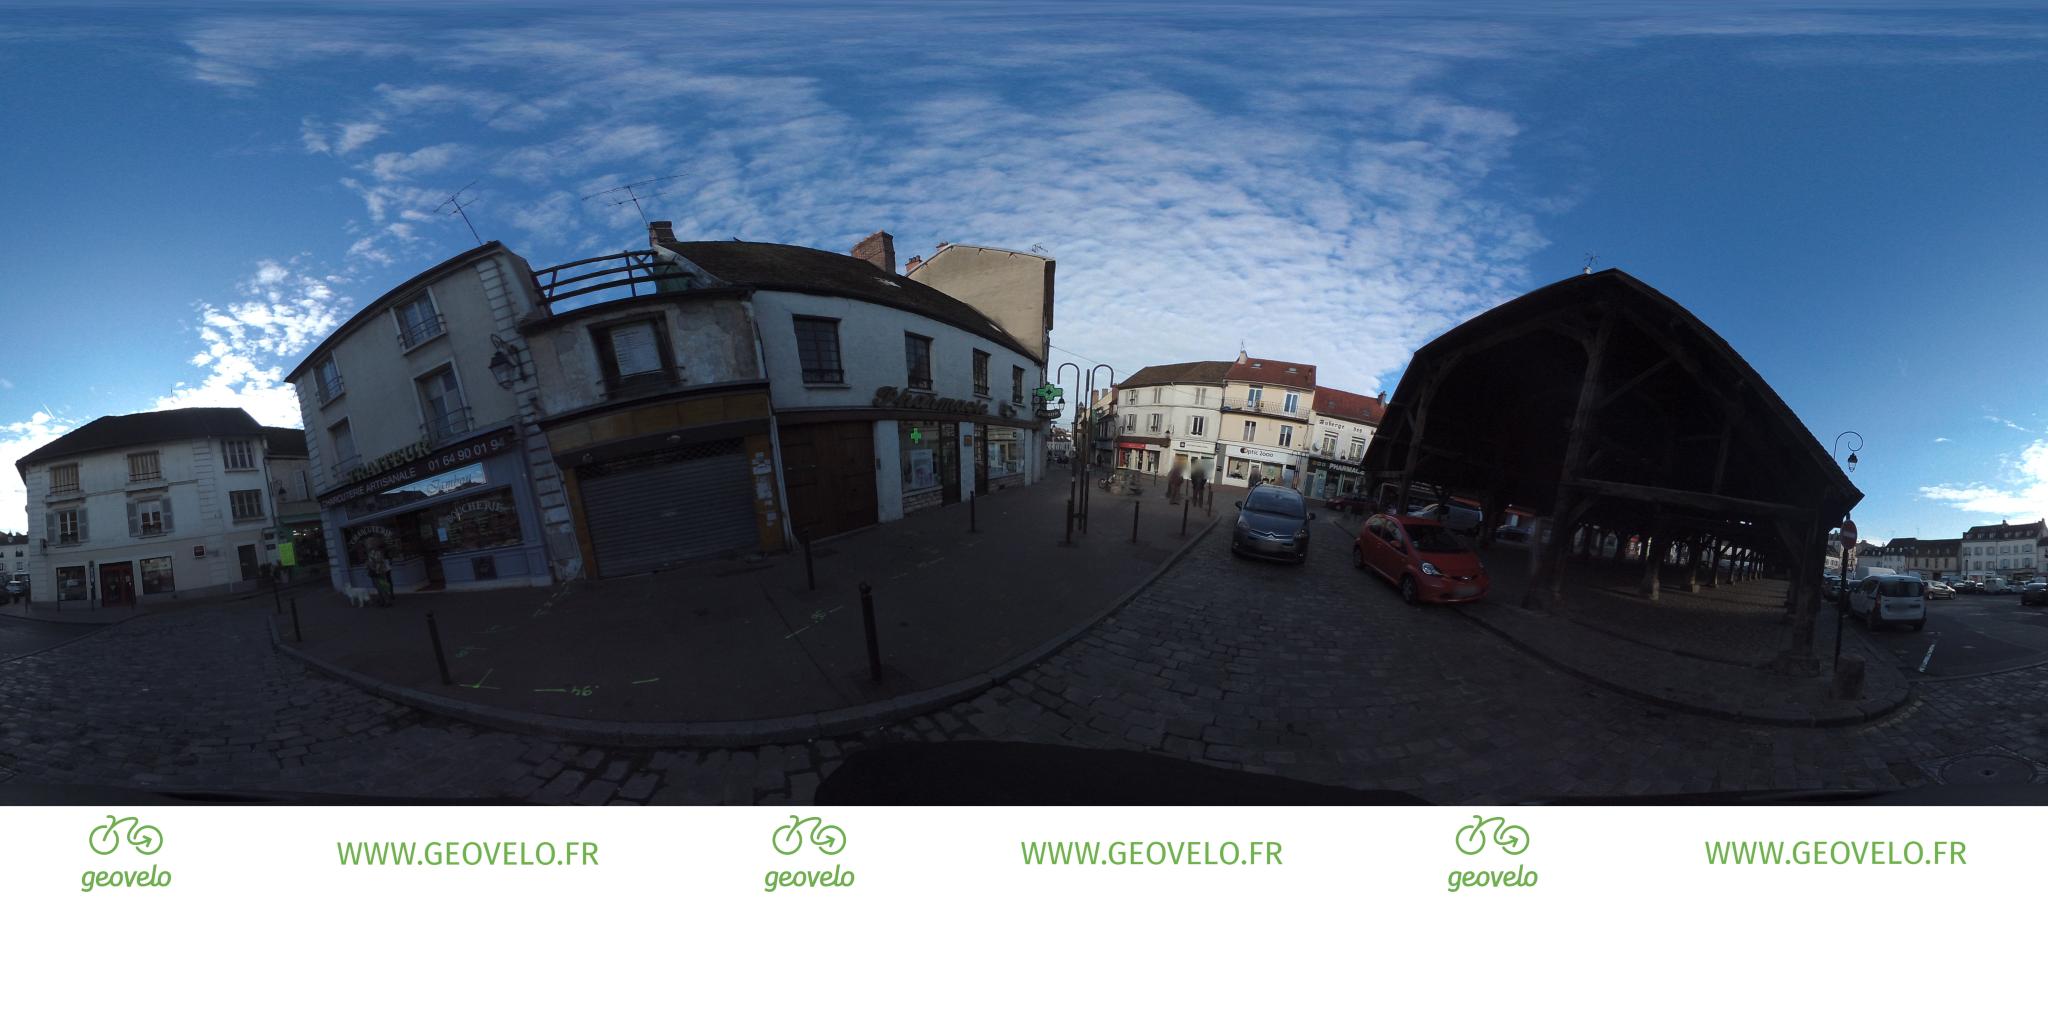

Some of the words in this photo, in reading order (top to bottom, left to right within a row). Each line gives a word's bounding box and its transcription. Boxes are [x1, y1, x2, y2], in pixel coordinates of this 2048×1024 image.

[366, 467, 416, 493] ARTISANALE
[427, 459, 440, 471] 01
[442, 453, 456, 466] 64
[457, 448, 471, 461] 90
[473, 443, 487, 455] 01
